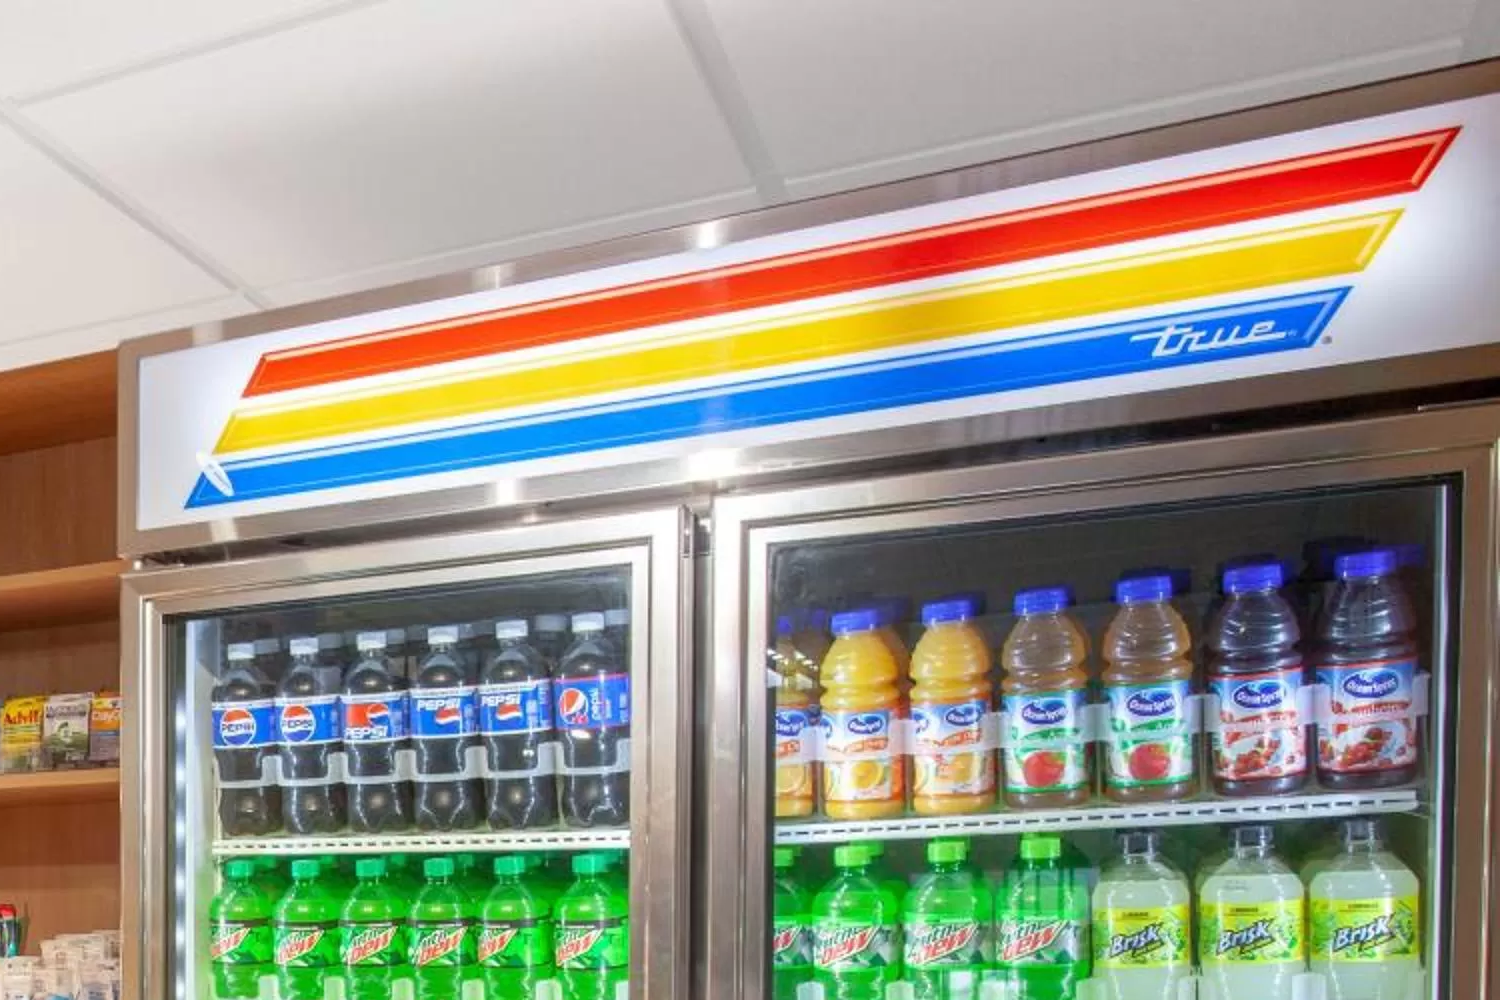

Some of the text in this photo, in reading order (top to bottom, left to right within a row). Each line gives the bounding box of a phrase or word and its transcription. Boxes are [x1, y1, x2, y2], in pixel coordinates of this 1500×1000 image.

[417, 699, 461, 711] PEPSI
[481, 694, 521, 706] PEPSI
[5, 711, 39, 724] Advil
[345, 726, 388, 738] PEPSI
